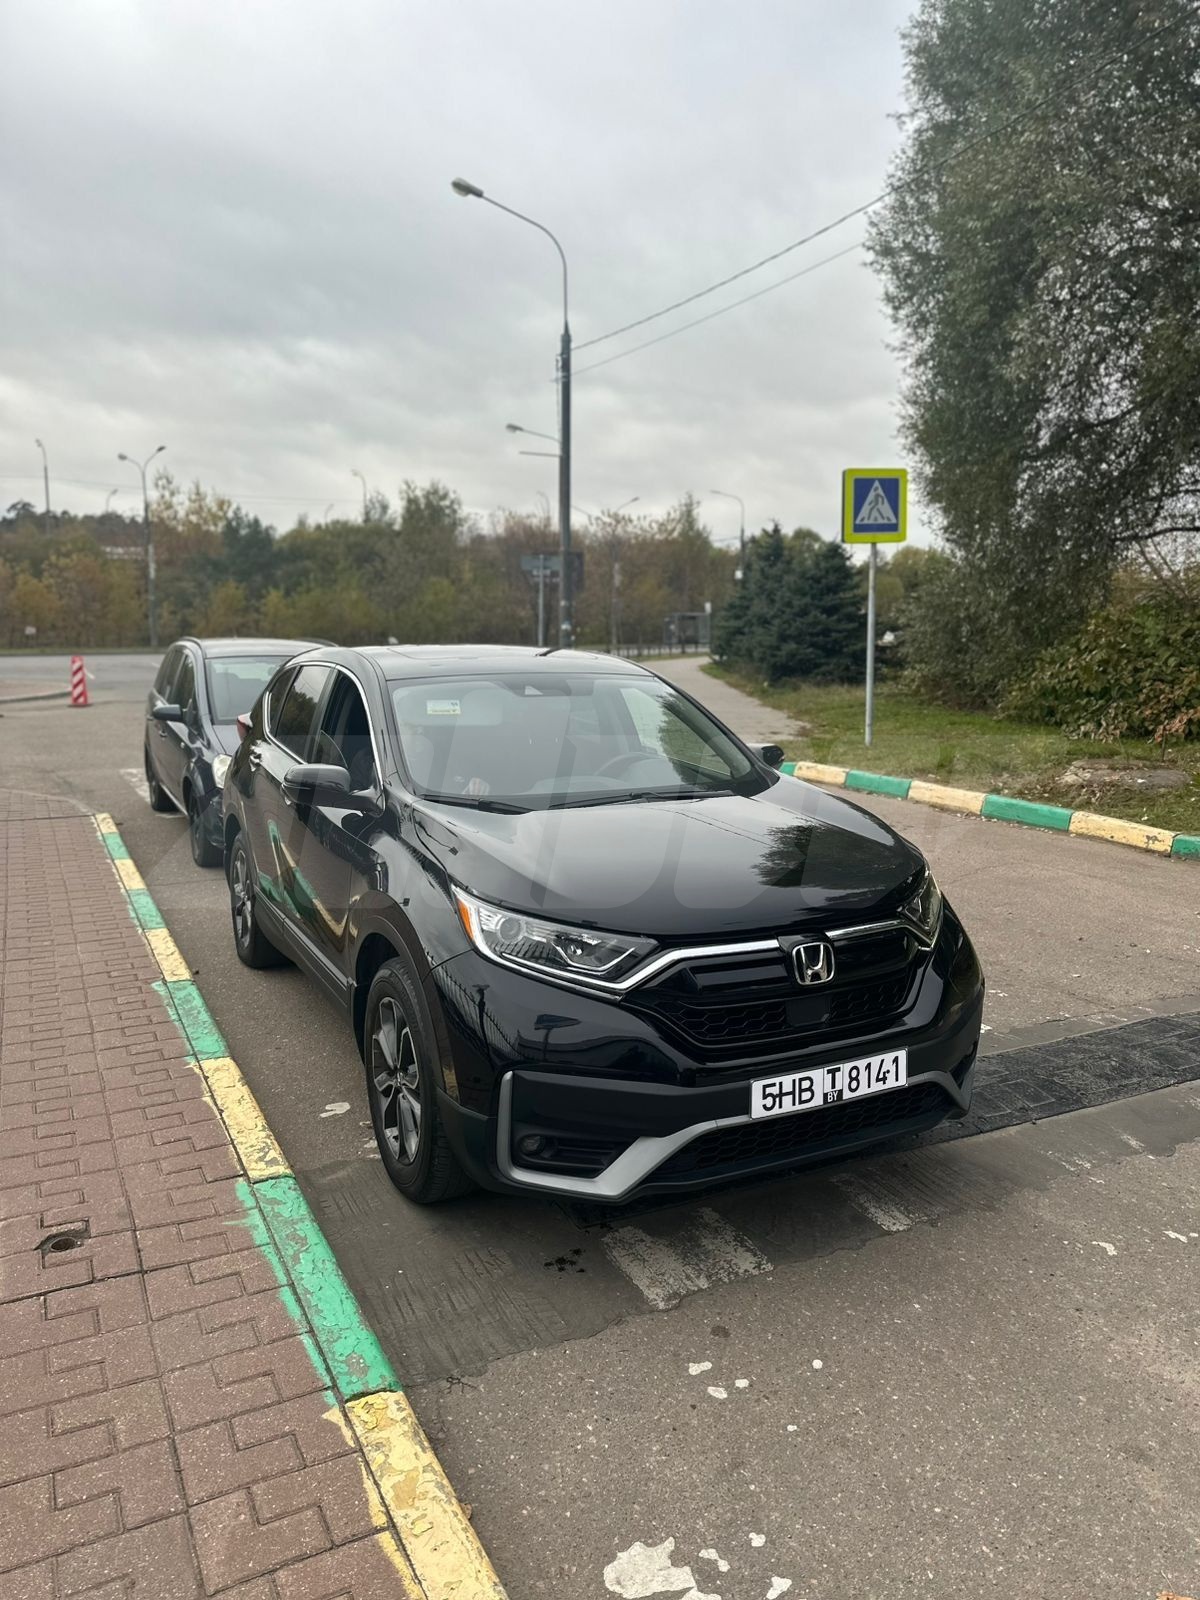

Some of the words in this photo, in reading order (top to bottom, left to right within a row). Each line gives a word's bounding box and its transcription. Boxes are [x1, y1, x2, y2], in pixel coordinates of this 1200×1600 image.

[762, 1076, 815, 1111] 5HB
[826, 1066, 841, 1089] T
[847, 1055, 899, 1093] 8141
[827, 1090, 839, 1103] BY
